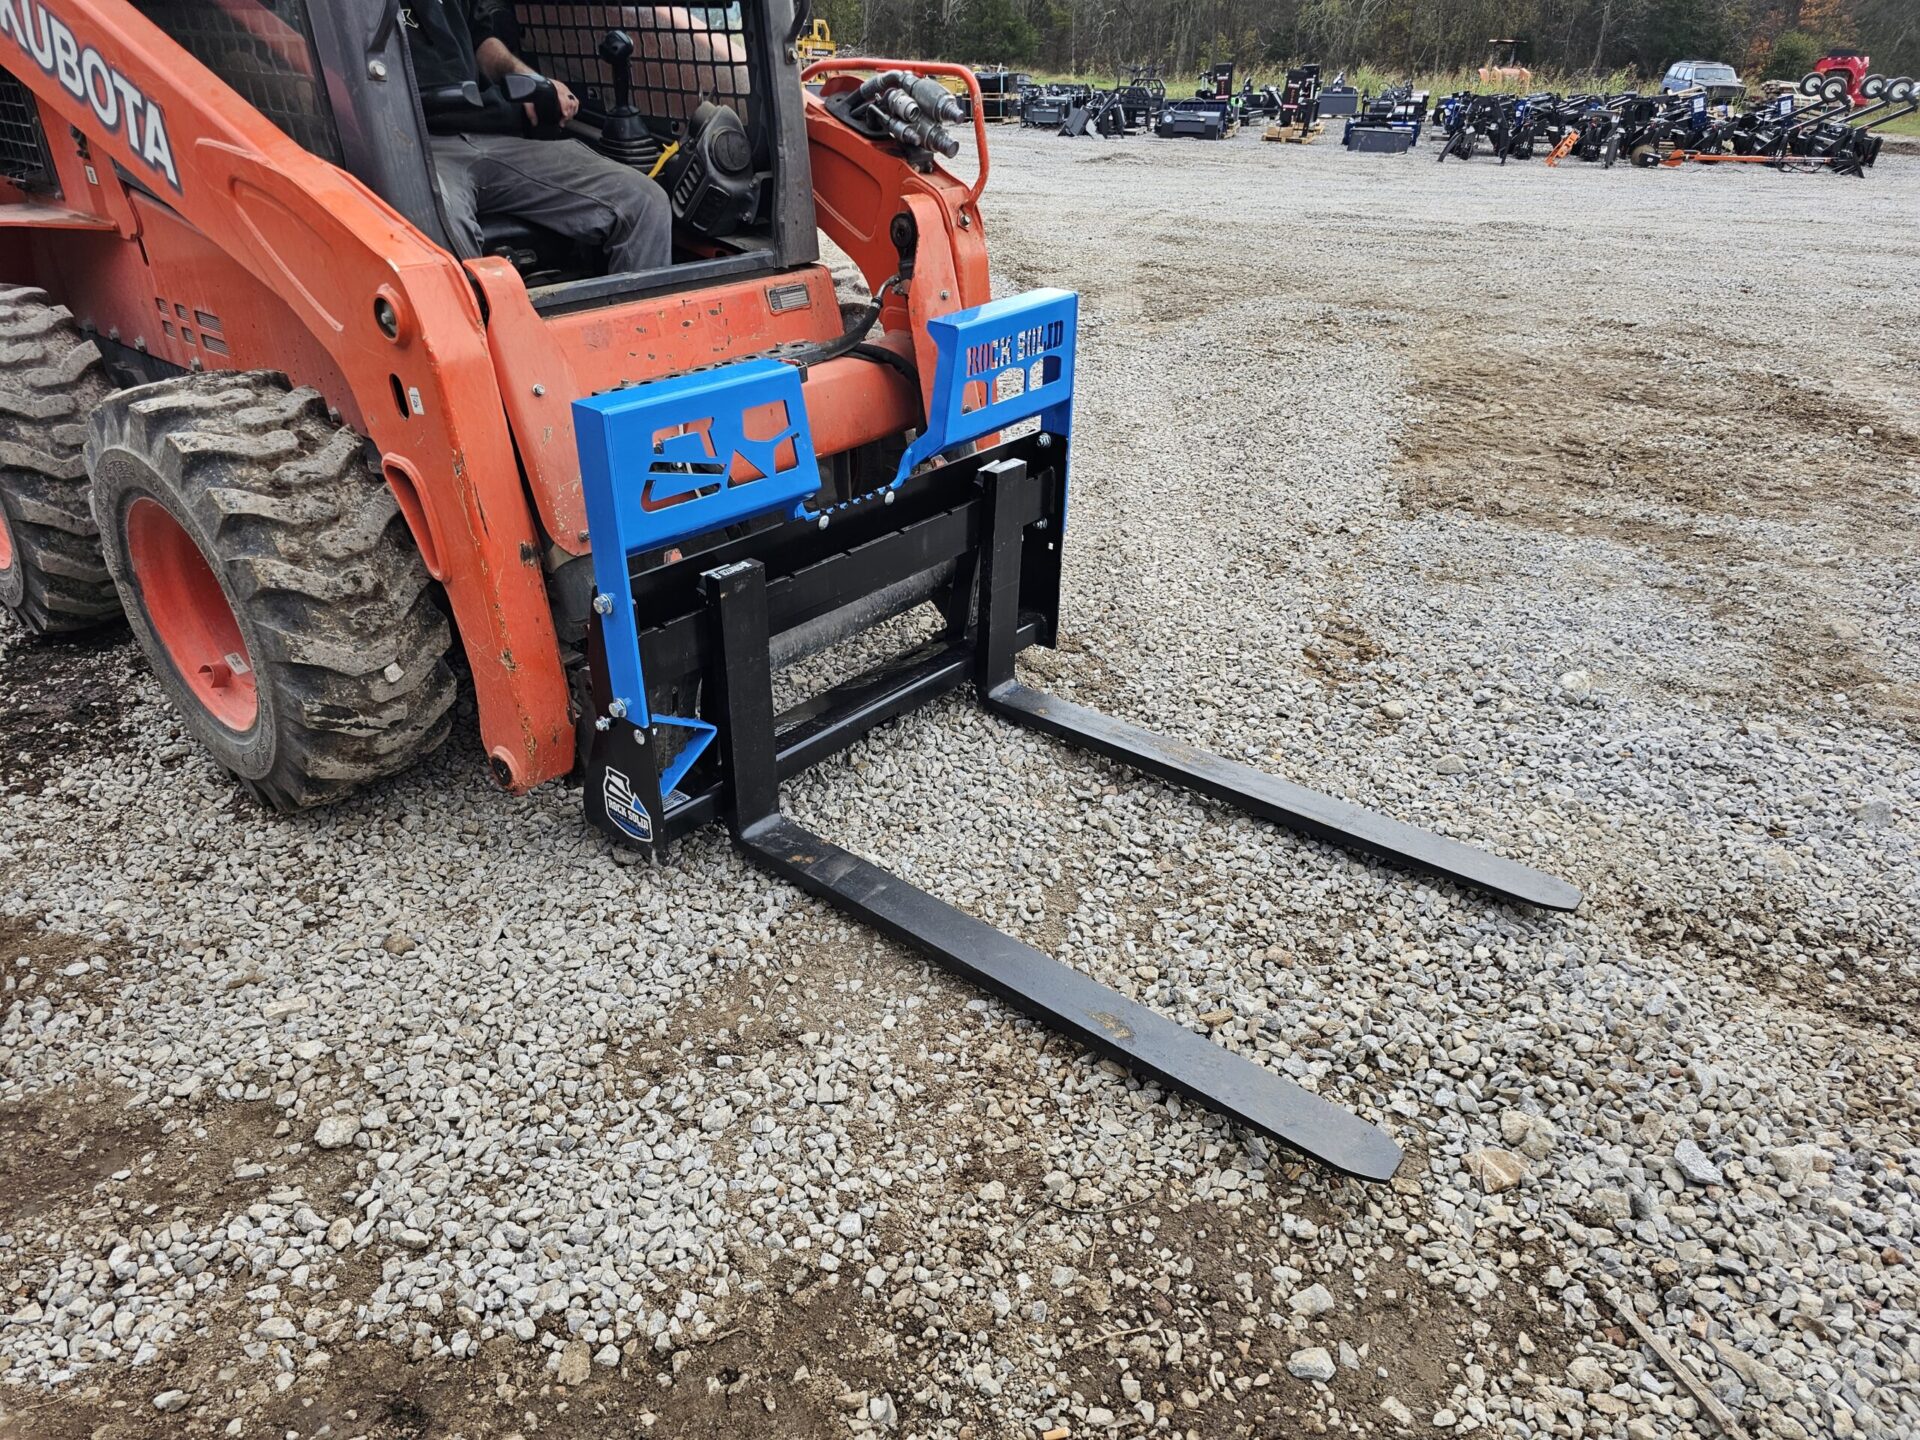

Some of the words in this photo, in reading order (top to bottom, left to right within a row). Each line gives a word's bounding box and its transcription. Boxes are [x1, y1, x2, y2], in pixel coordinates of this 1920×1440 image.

[967, 335, 1012, 376] ROCK
[1017, 321, 1063, 360] SOLID
[608, 799, 628, 817] ROCK
[628, 810, 649, 830] SOLID
